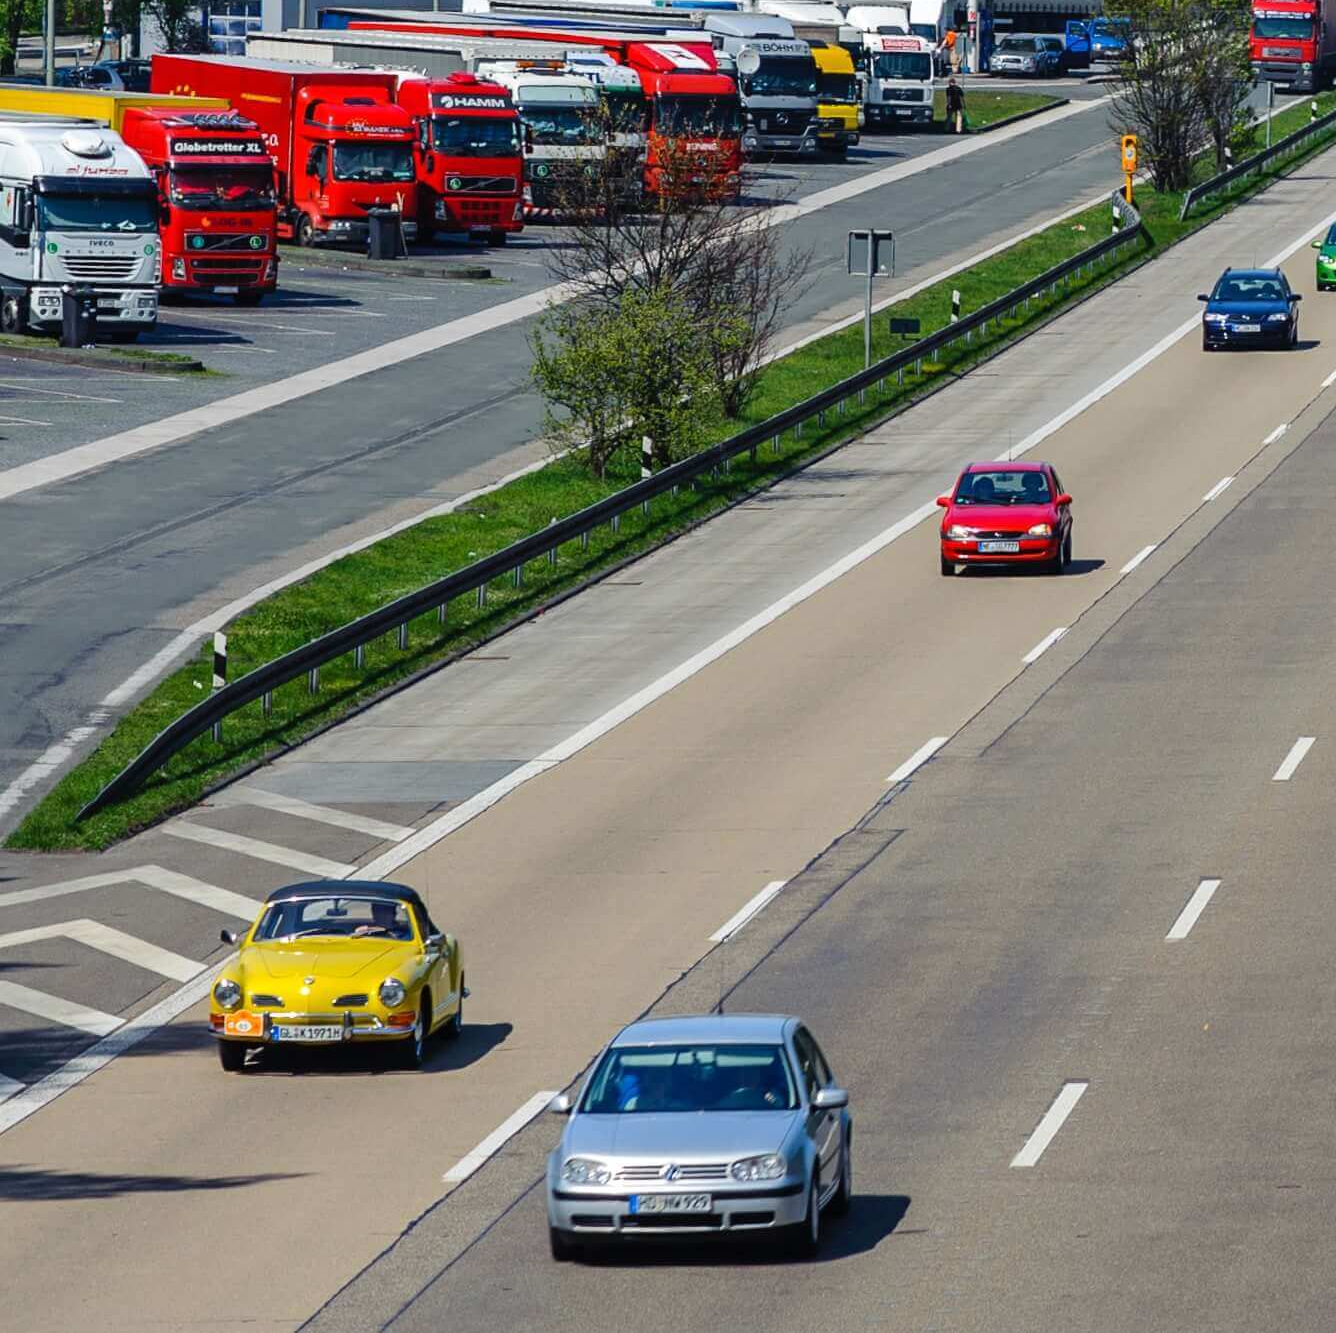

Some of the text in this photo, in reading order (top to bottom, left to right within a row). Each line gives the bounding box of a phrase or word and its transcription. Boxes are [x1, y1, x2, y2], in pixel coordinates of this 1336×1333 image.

[763, 41, 794, 52] BÖHM
[454, 97, 506, 108] HAMM
[174, 142, 262, 153] Globetrotter XL
